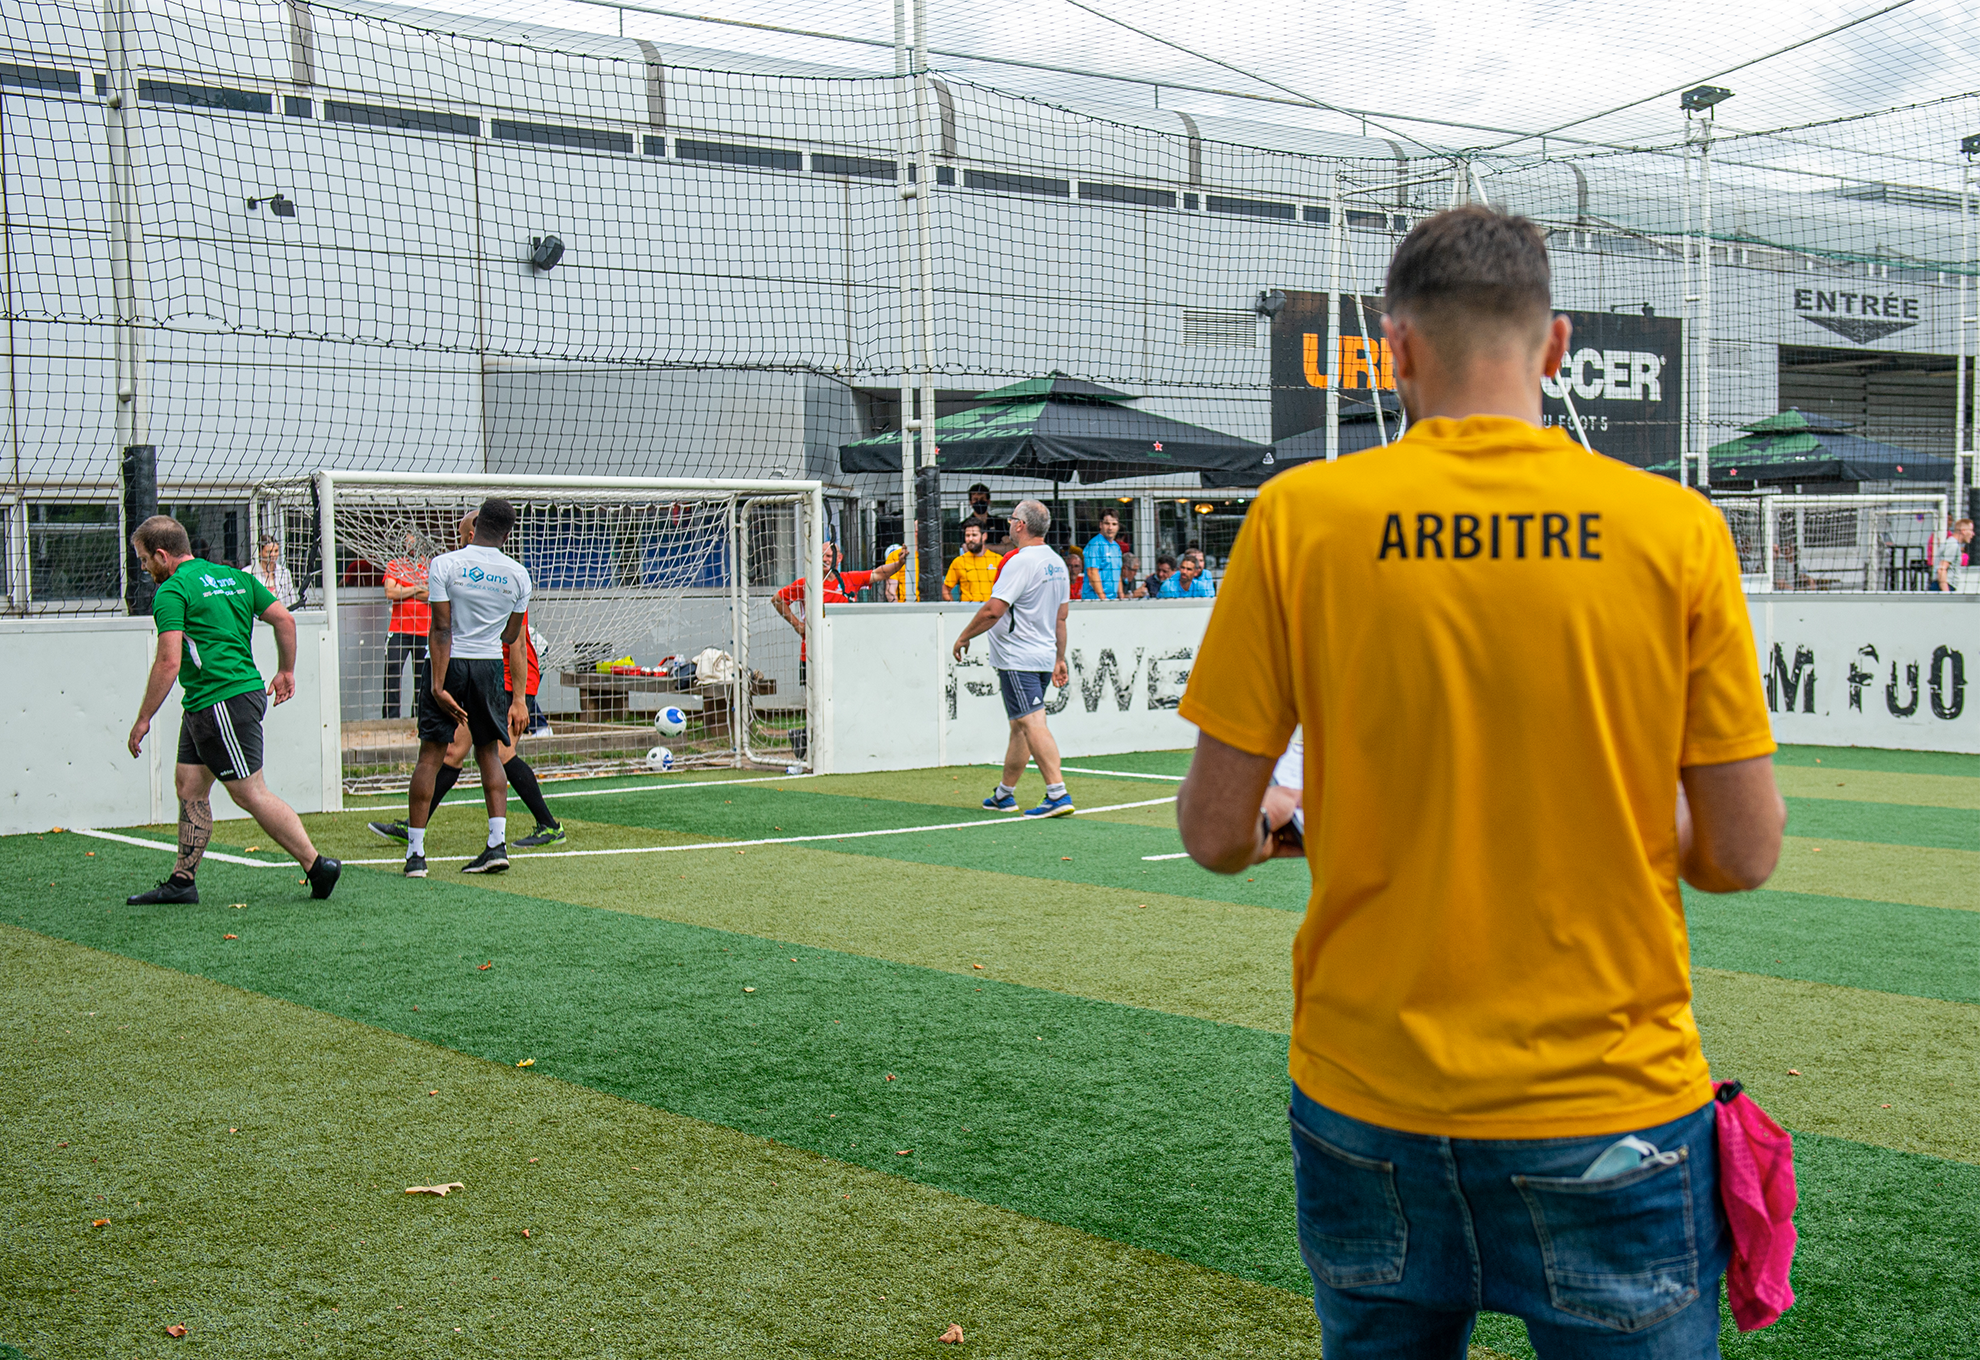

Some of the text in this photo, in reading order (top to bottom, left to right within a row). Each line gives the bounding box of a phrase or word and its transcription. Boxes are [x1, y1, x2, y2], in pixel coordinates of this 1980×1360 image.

[1794, 288, 1920, 320] ENTRÉE
[1379, 513, 1602, 559] ARBITRE
[486, 574, 508, 585] ans
